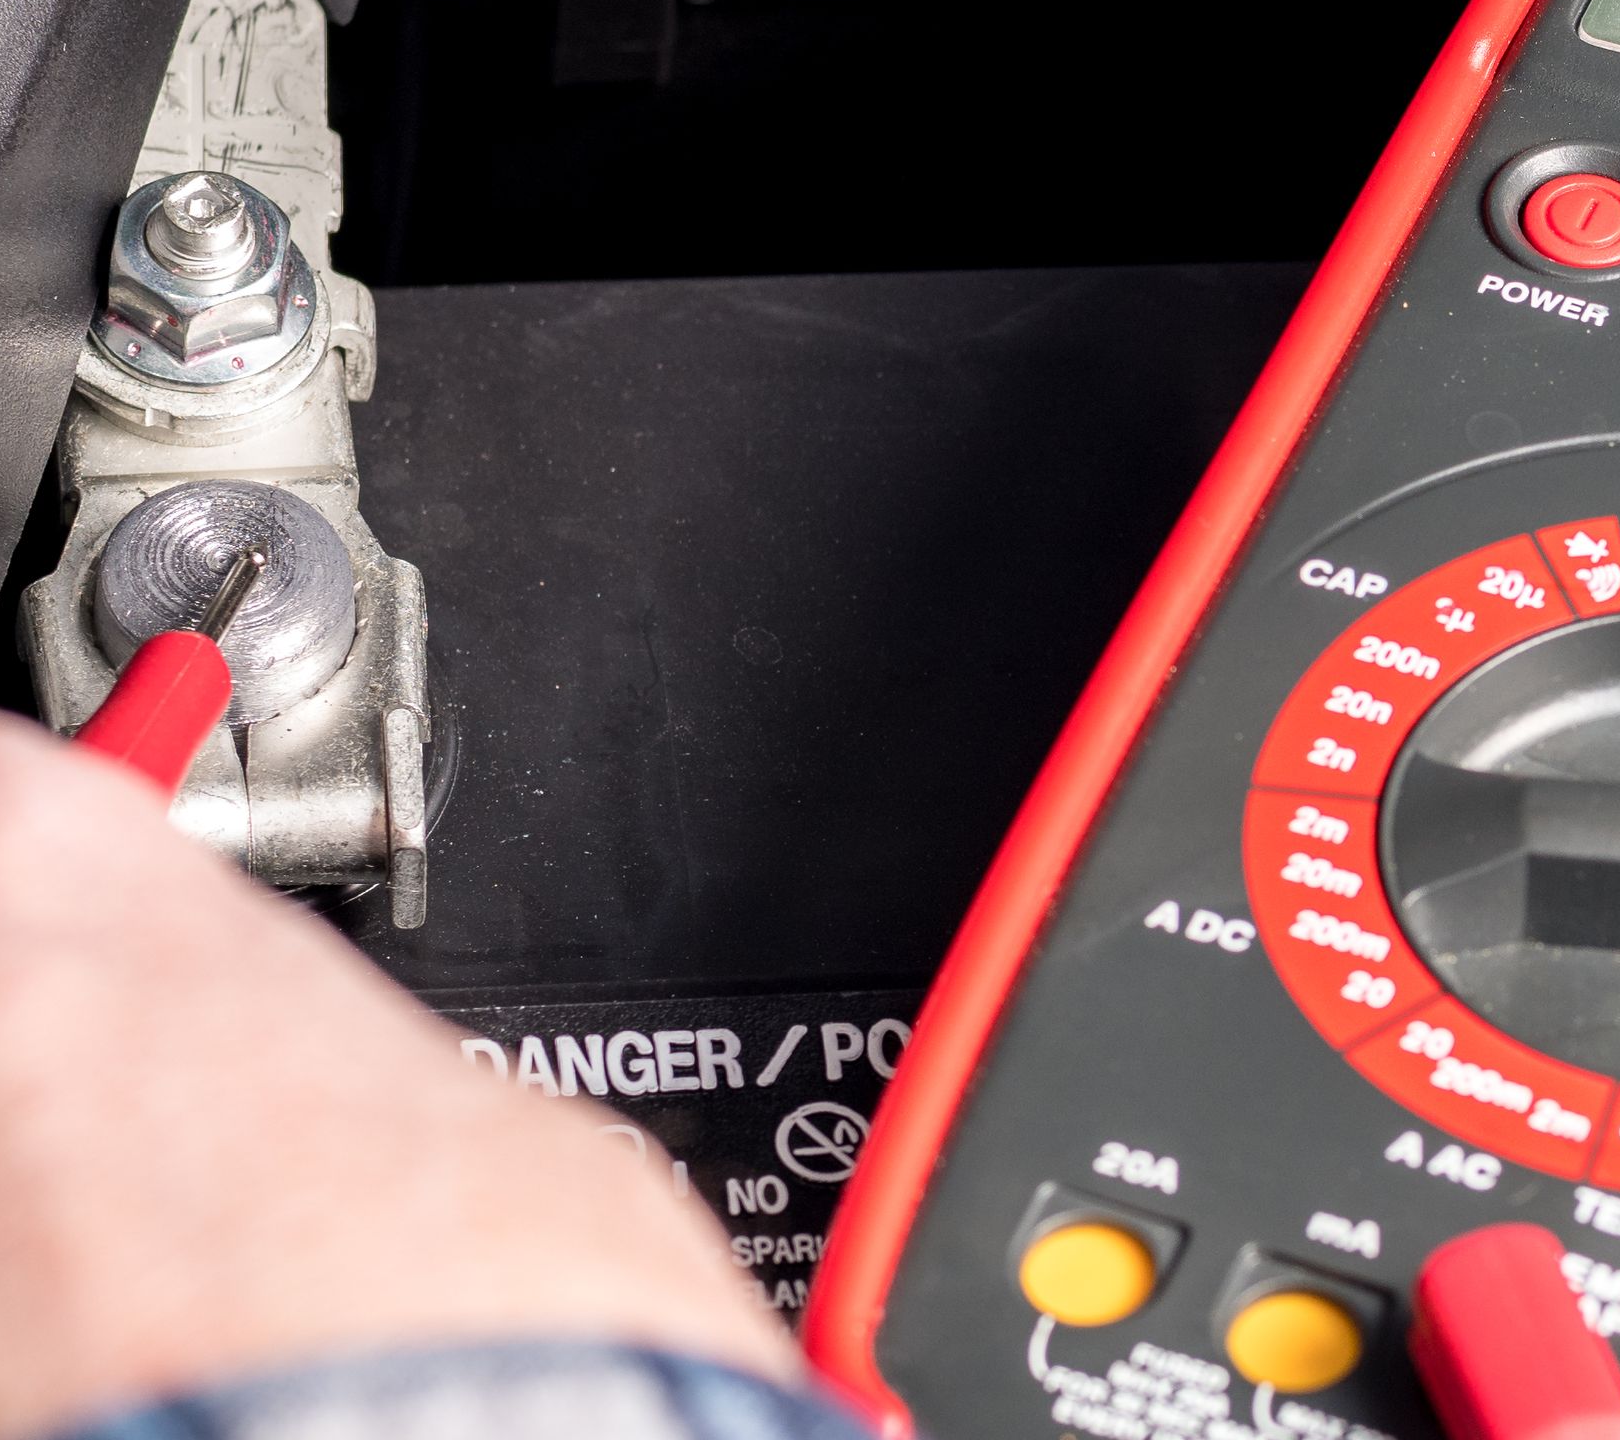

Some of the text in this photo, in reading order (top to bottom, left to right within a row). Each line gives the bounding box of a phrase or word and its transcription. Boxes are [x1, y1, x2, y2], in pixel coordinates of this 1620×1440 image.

[1476, 274, 1608, 328] POWER
[1299, 558, 1389, 599] CAP
[1352, 635, 1441, 681] 200n
[1324, 684, 1393, 726] 20n
[1306, 736, 1357, 772] 2n
[1288, 805, 1350, 845] 2m
[1281, 852, 1363, 899] 20m
[1143, 899, 1256, 953] A DC
[1288, 908, 1392, 962] 200m
[1340, 969, 1395, 1009] 20
[460, 1027, 744, 1098] DANGER
[1398, 1019, 1455, 1060] 20
[1092, 1141, 1180, 1195] 20A
[1384, 1130, 1502, 1192] A AC
[725, 1174, 789, 1216] NO
